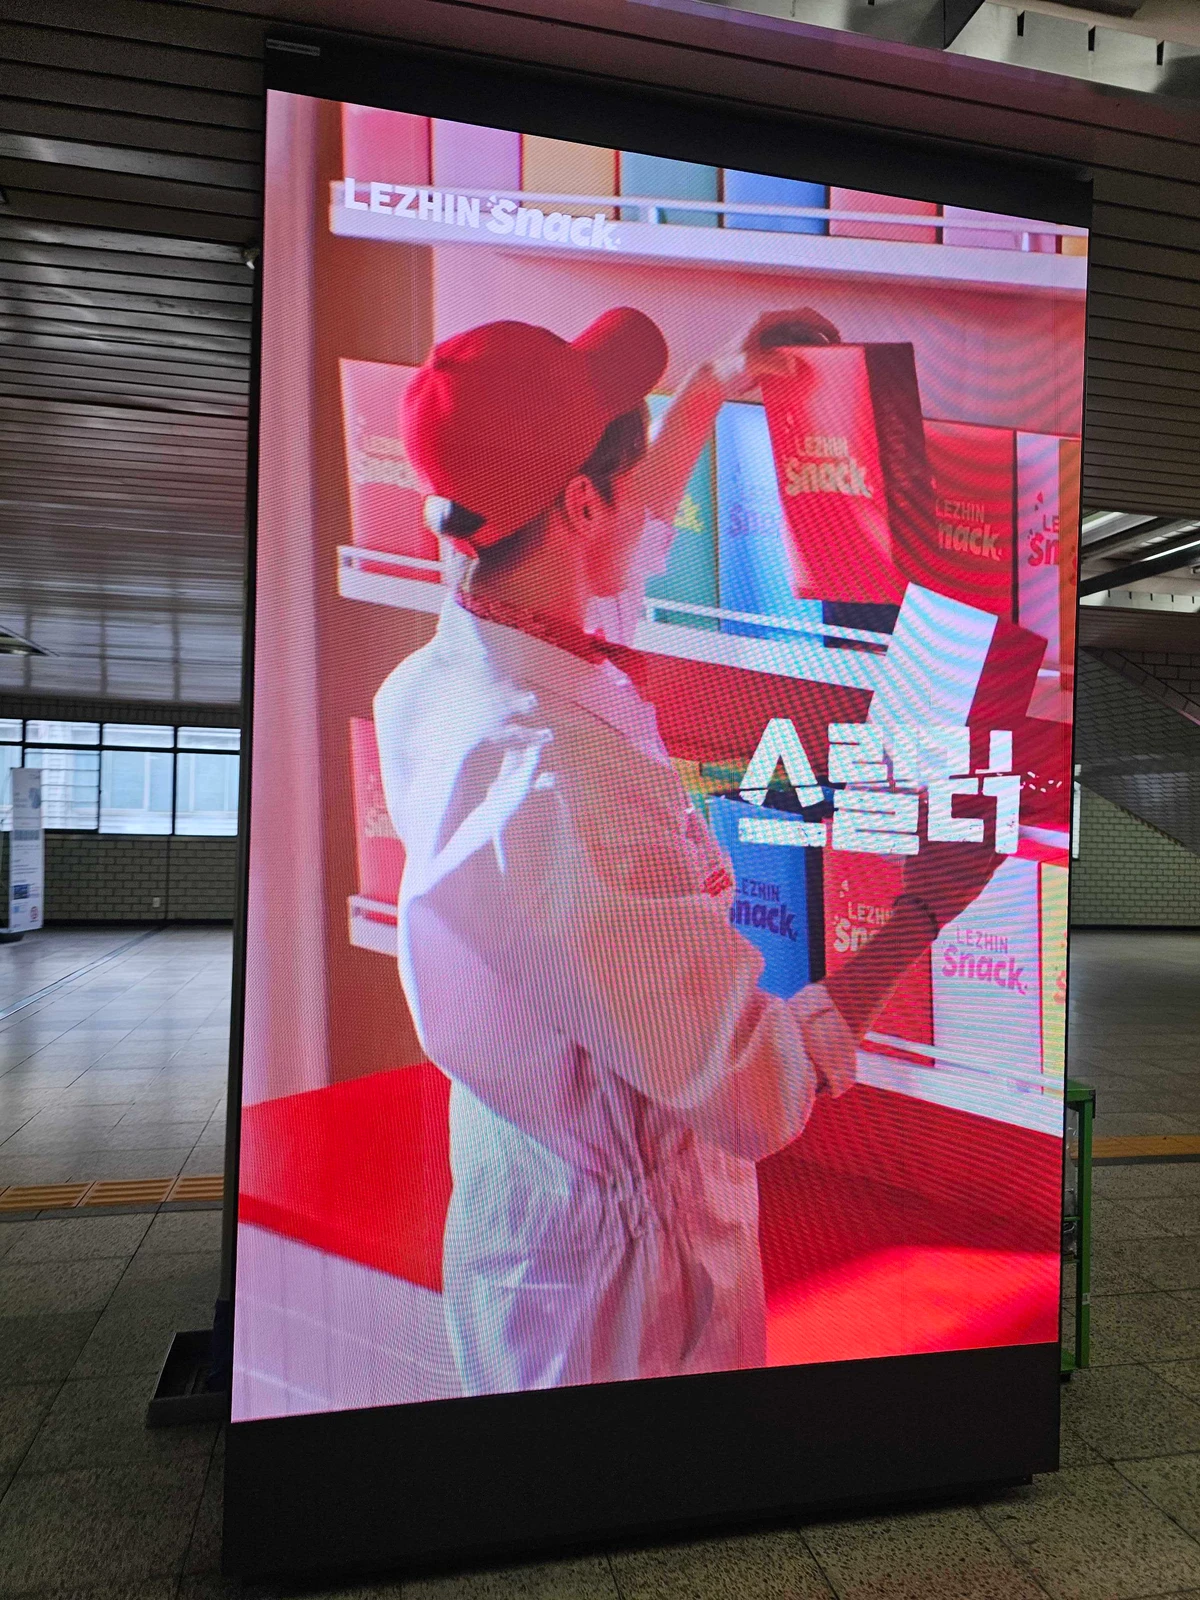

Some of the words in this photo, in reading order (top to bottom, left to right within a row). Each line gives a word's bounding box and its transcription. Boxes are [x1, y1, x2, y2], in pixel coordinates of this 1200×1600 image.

[344, 177, 481, 229] LEZHIN
[794, 435, 849, 458] LEZHIN
[935, 498, 985, 524] LEZHIN
[738, 718, 1021, 855] 스릴러
[956, 925, 1009, 954] LEZHIN
